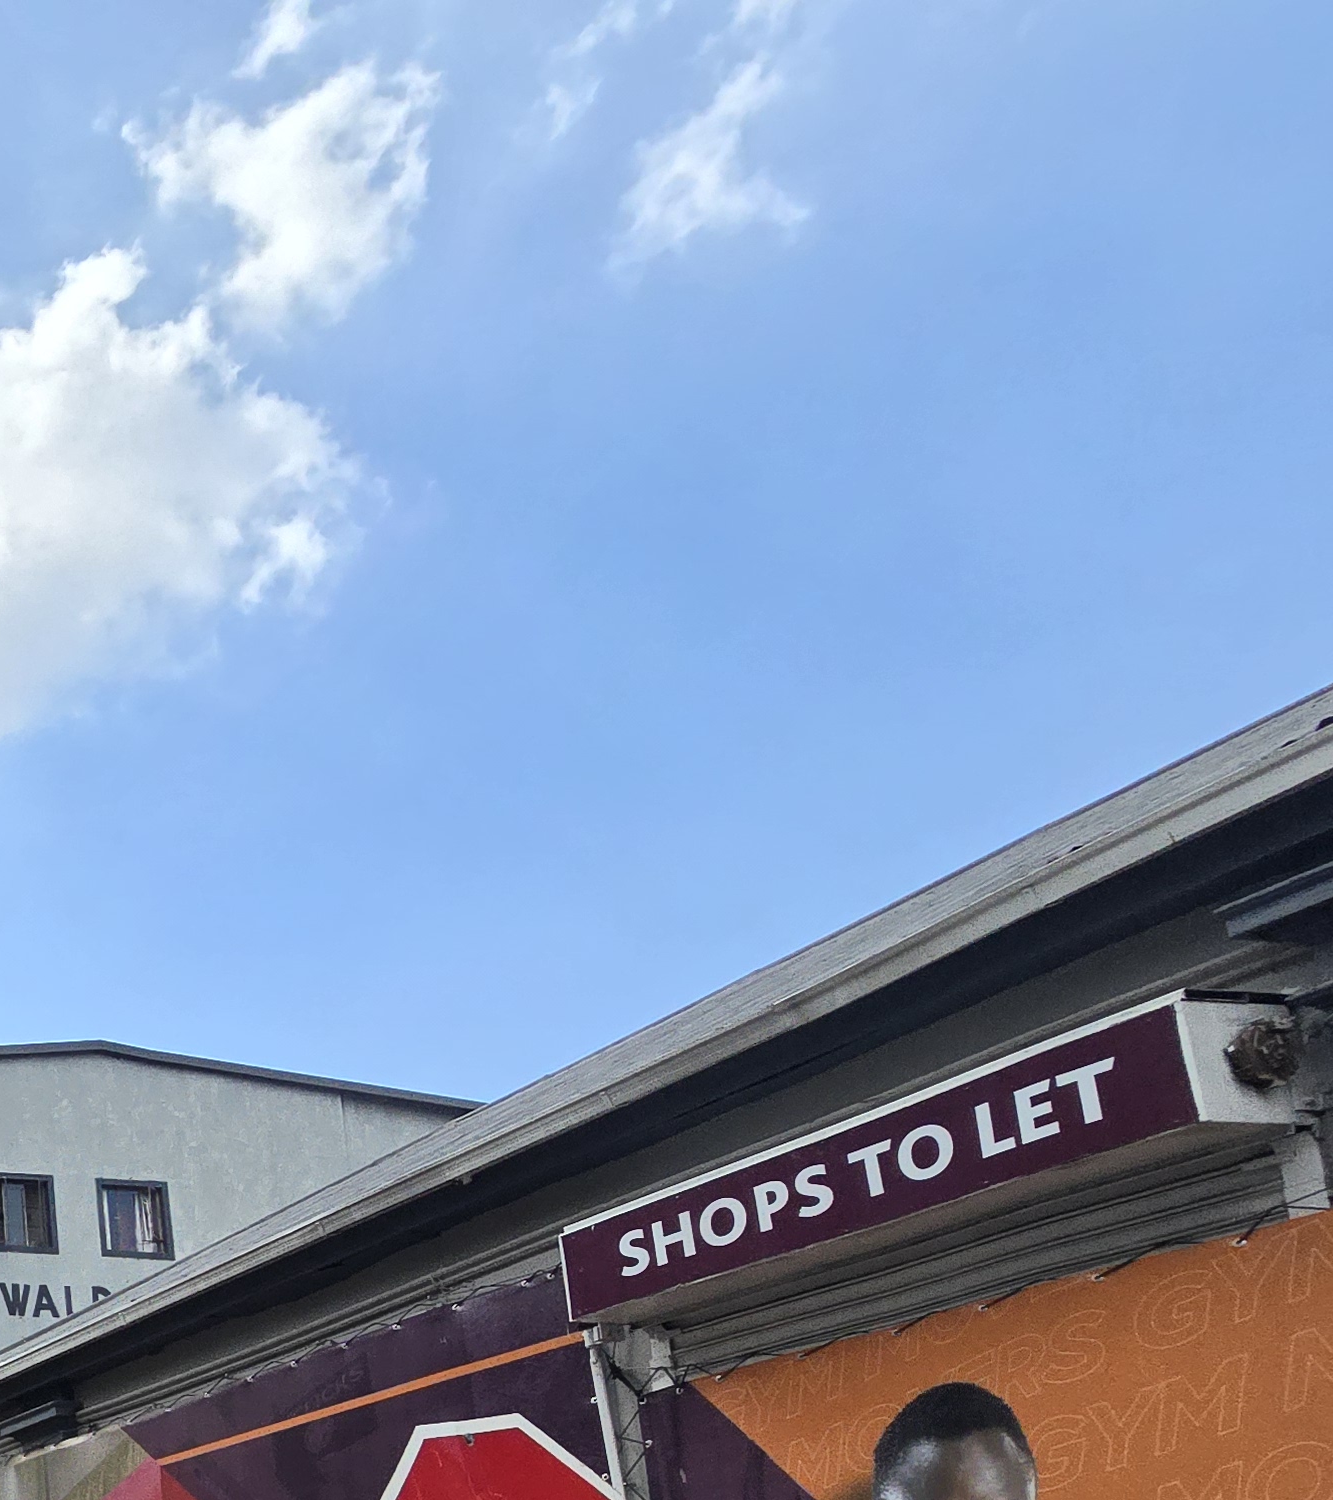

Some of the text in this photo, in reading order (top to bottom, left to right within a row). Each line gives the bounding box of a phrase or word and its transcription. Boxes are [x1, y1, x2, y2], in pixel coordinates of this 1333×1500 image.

[619, 1057, 1115, 1277] SHOPS TO LET
